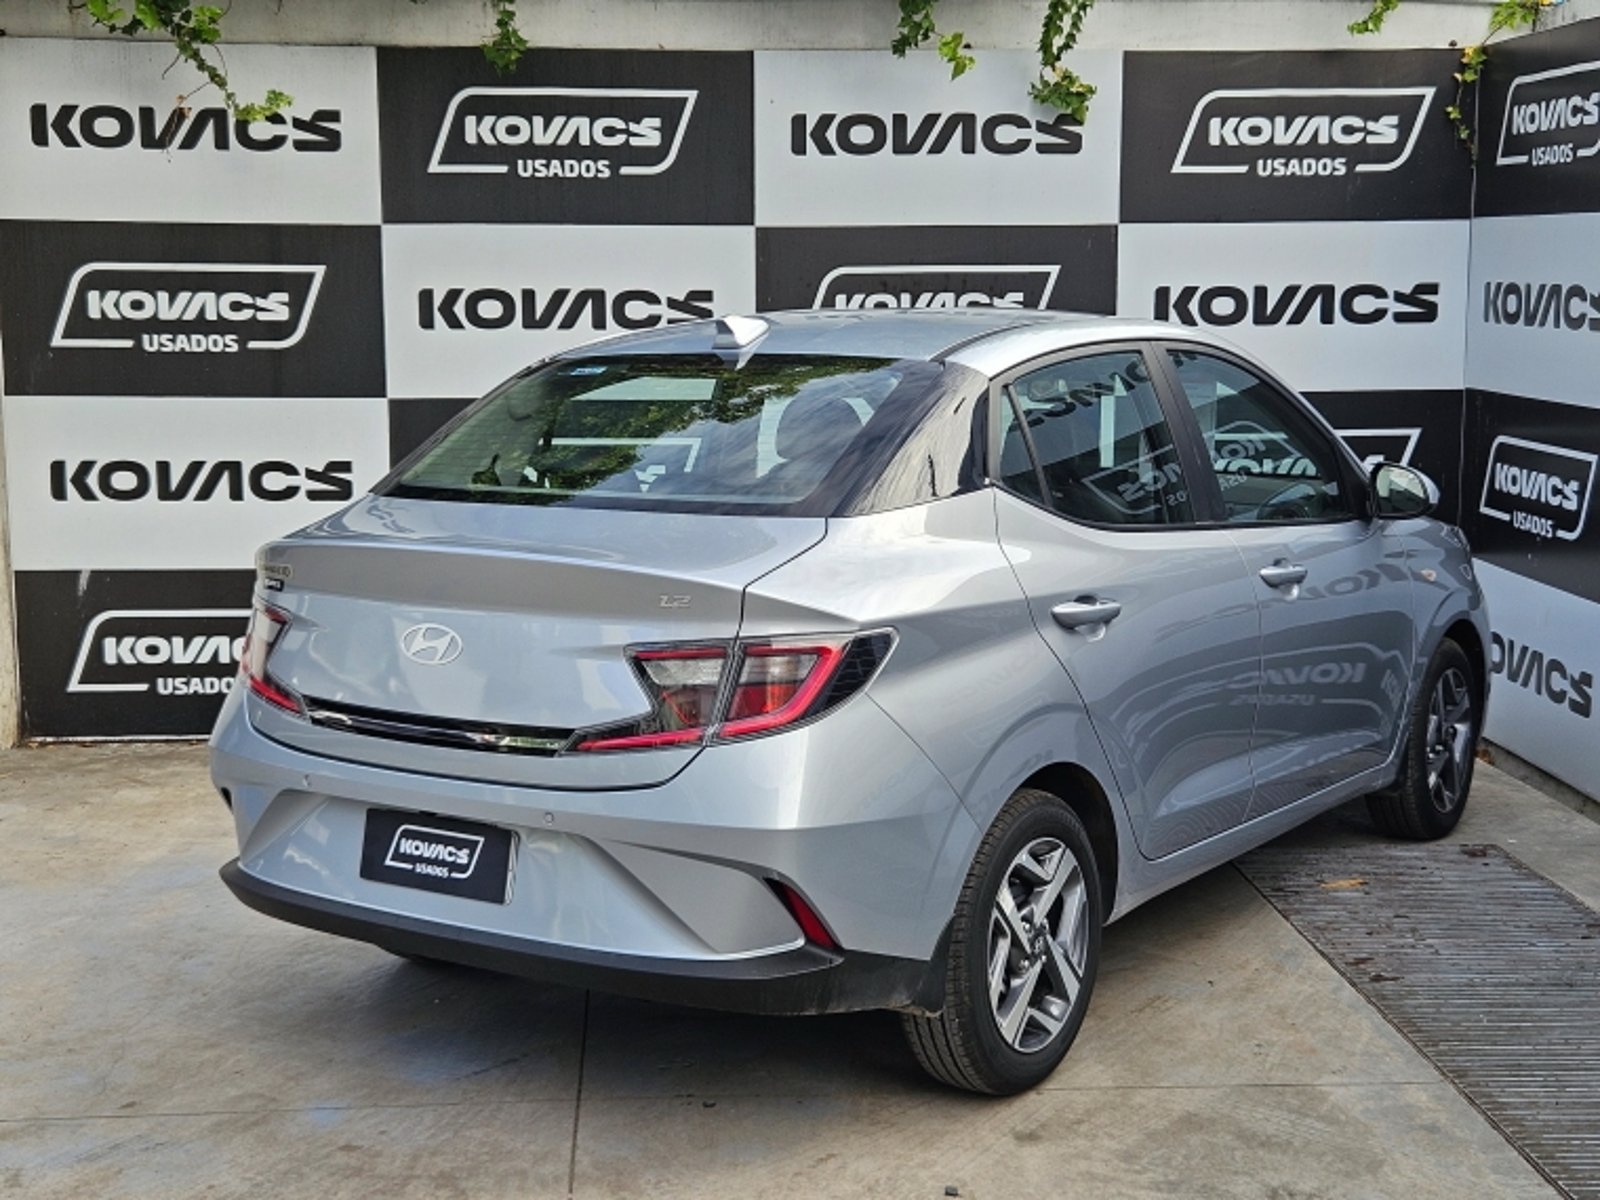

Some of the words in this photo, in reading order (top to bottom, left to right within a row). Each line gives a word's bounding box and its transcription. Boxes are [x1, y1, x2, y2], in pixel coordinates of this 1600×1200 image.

[30, 103, 341, 152] KOVACS
[1511, 92, 1600, 135] KOVACS
[464, 114, 662, 148] KOVACS
[791, 112, 1083, 155] KOVACS
[1207, 114, 1399, 147] KOVACS
[516, 159, 611, 178] USADOS
[1256, 157, 1347, 176] USADOS
[1531, 142, 1573, 166] USADOS
[86, 290, 290, 322] KOVACS
[418, 288, 714, 330] KOVACS
[1154, 282, 1439, 327] KOVACS
[141, 333, 239, 353] USADOS
[50, 460, 352, 502] KOVACS
[1493, 462, 1580, 512] KOVACS
[1512, 509, 1554, 538] USADOS
[103, 636, 244, 665] KOVA
[157, 677, 236, 695] USADO
[1490, 631, 1593, 719] OVACS
[399, 837, 470, 864] KOVACS
